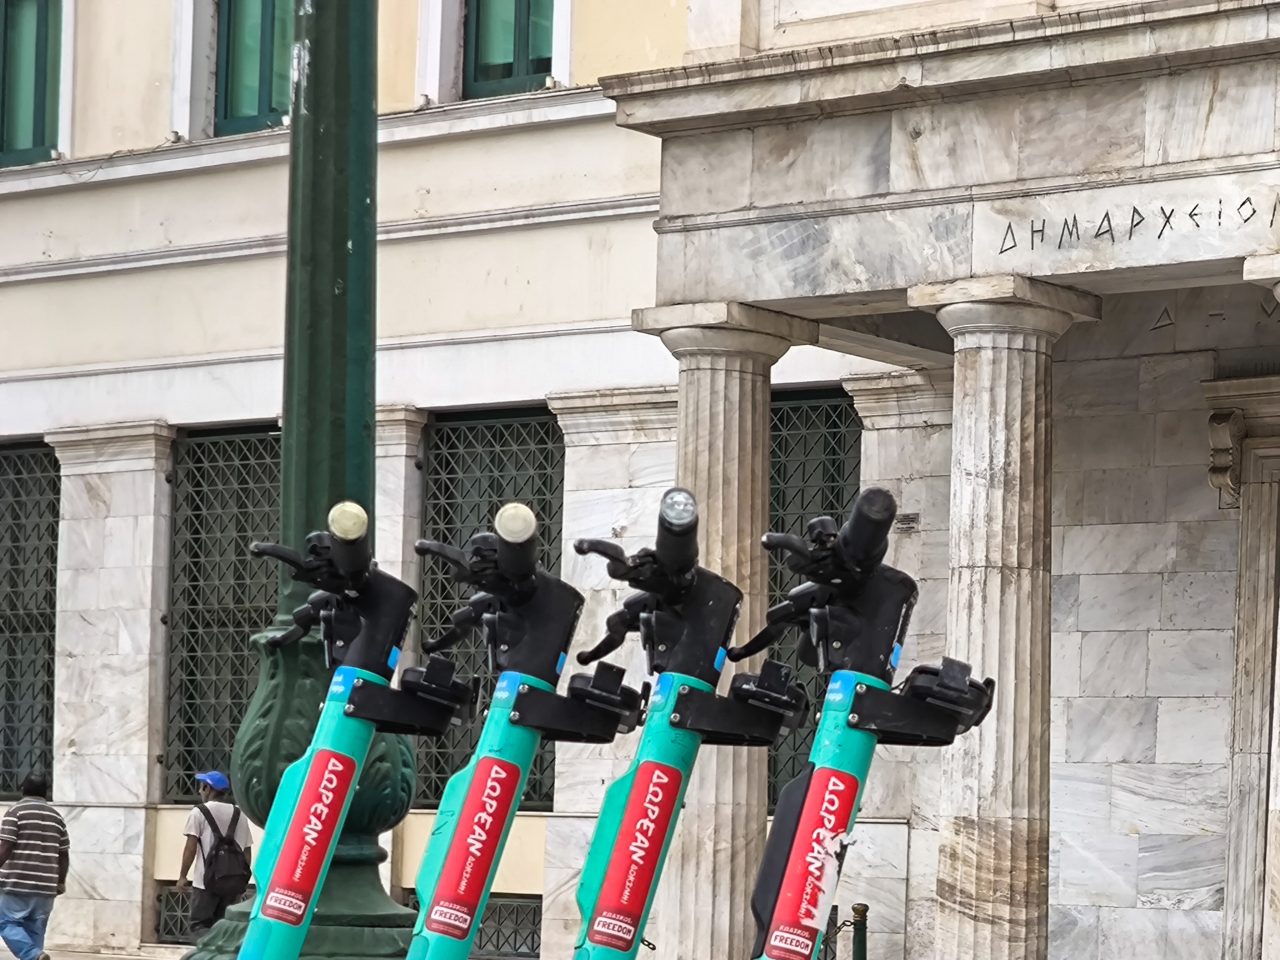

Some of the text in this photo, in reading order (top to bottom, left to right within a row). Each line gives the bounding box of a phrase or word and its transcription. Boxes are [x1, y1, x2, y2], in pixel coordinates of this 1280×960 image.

[303, 757, 344, 847] ΔΩΡΕΑΝ
[467, 764, 508, 857] ΔΩΡΕΑΝ
[629, 769, 669, 865] ΔΩΡΕΑΝ
[267, 894, 304, 913] FREEDOM
[433, 908, 470, 926] FREEDOM
[596, 919, 633, 938] FREEDOM
[773, 934, 811, 952] FREEDOM
